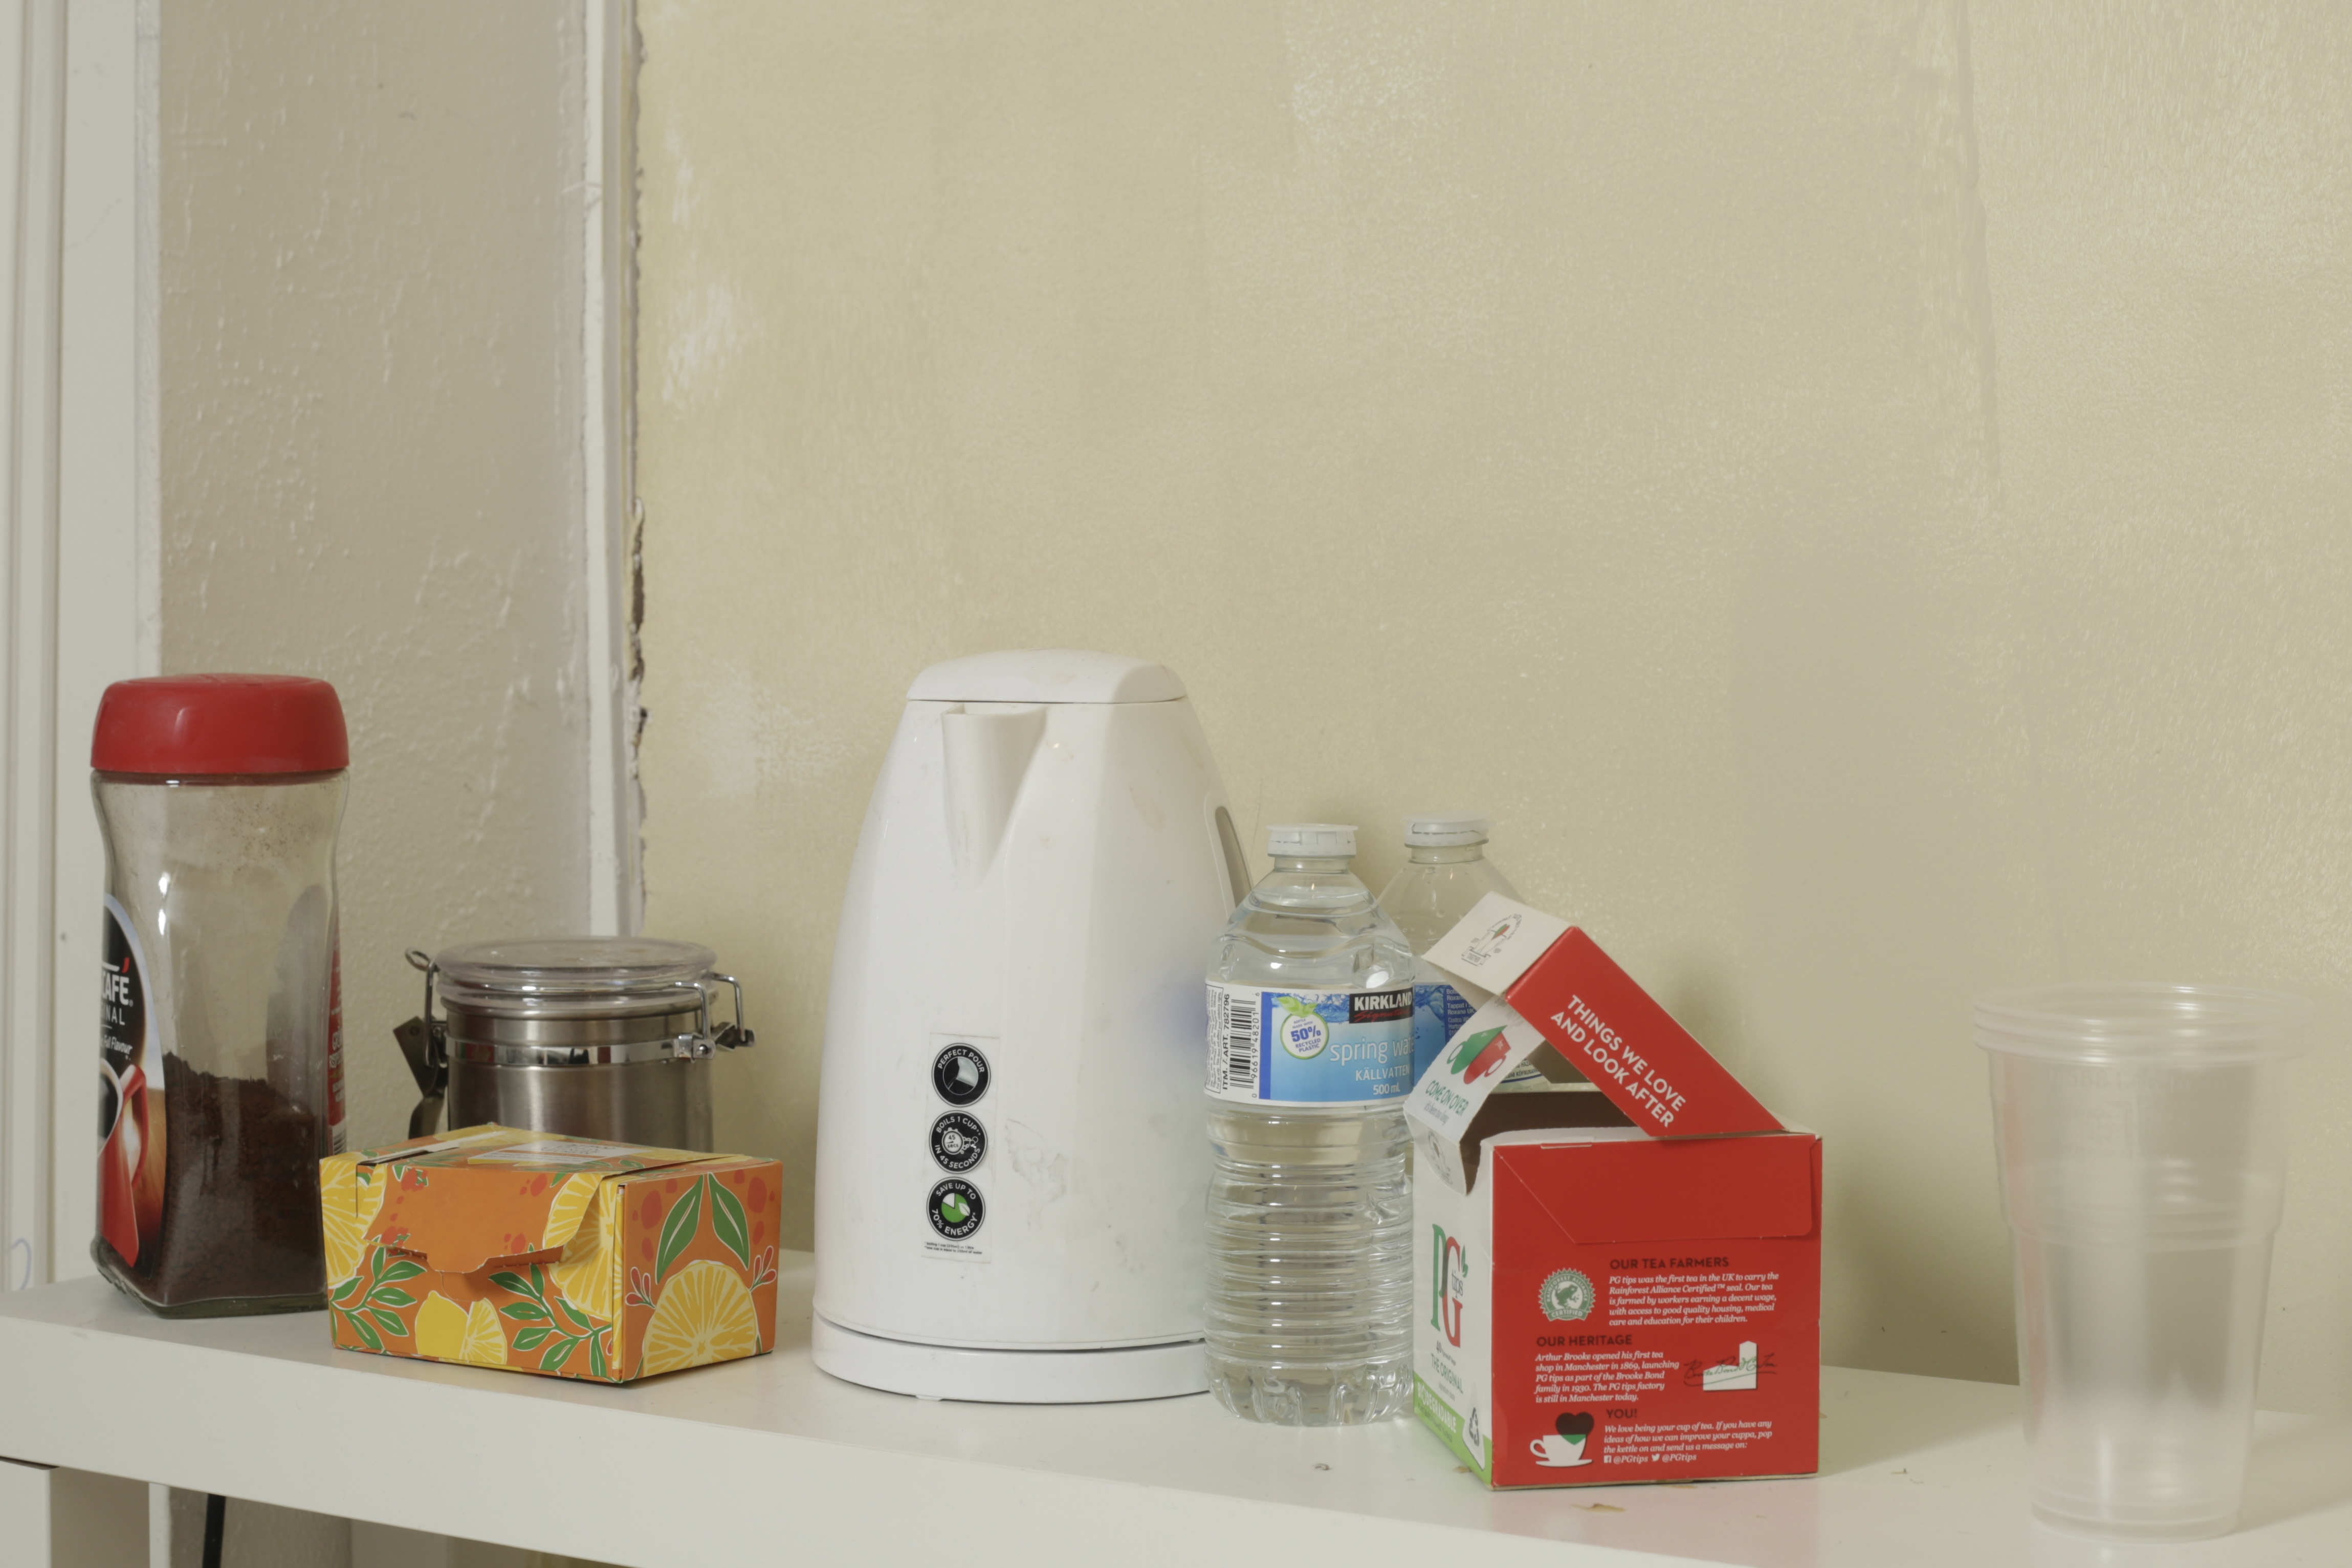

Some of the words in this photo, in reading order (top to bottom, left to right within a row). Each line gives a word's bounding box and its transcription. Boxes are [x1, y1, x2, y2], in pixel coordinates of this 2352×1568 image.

[1354, 991, 1413, 1011] KIRKLAND
[1290, 1025, 1321, 1042] 50%
[1295, 1039, 1321, 1048] RECYCLED
[1299, 1044, 1319, 1052] PLASTIC
[1330, 1037, 1388, 1066] spring
[1393, 1035, 1414, 1057] wate
[1568, 995, 1622, 1051] THINGS
[1622, 1046, 1647, 1074] WE
[1644, 1069, 1686, 1111] LOVE
[937, 1049, 967, 1069] PERFECT
[969, 1052, 984, 1072] POUR
[1356, 1064, 1410, 1080] KÄLLVATTEN
[1550, 1011, 1586, 1043] AND
[1584, 1039, 1629, 1085] LOOK
[1625, 1081, 1674, 1128] AFTER
[1373, 1084, 1389, 1095] 500
[1425, 1080, 1446, 1101] COME
[1441, 1090, 1455, 1106] ON
[1449, 1095, 1468, 1116] OVER
[936, 1116, 955, 1133] BOILS
[935, 1145, 941, 1154] IN
[940, 1156, 949, 1164] 45
[949, 1148, 980, 1168] SECONDS
[936, 1183, 953, 1196] SAVE
[967, 1188, 976, 1199] TO
[932, 1209, 943, 1228] 70%
[1610, 1259, 1638, 1269] OUR
[1642, 1258, 1665, 1269] TEA
[1670, 1257, 1729, 1268] FARMERS
[1431, 1224, 1463, 1348] PG
[1452, 1269, 1463, 1298] tips
[1622, 1276, 1636, 1285] tips
[1667, 1275, 1685, 1284] first
[1547, 1276, 1570, 1301] RAINFOREST
[1572, 1277, 1588, 1301] ALLIANCE
[1609, 1287, 1649, 1296] Rainforest
[1650, 1285, 1681, 1293] Alliance
[1726, 1283, 1743, 1291] seal.
[1616, 1296, 1645, 1306] farmed
[1647, 1296, 1656, 1306] by
[1658, 1295, 1689, 1304] workers
[1690, 1295, 1720, 1304] earning
[1551, 1309, 1583, 1317] CERTIFIED
[1610, 1307, 1626, 1315] with
[1663, 1306, 1682, 1316] good
[1683, 1305, 1710, 1315] quality
[1745, 1303, 1774, 1312] medical
[1628, 1317, 1642, 1325] and
[1681, 1316, 1694, 1326] for
[1715, 1315, 1747, 1323] children.
[1436, 1340, 1441, 1354] 40
[1537, 1336, 1565, 1347] OUR
[1569, 1334, 1632, 1346] HERITAGE
[1535, 1353, 1563, 1361] Arthur
[1564, 1352, 1591, 1360] Brooke
[1592, 1351, 1620, 1362] opened
[1622, 1351, 1632, 1359] his
[1632, 1350, 1651, 1360] first
[1535, 1363, 1554, 1373] shop
[1565, 1362, 1610, 1371] Manchester
[1620, 1362, 1640, 1370] 1869,
[1642, 1360, 1679, 1370] launching
[1431, 1353, 1439, 1373] THE
[1441, 1362, 1463, 1394] ORIGINAL
[1534, 1384, 1560, 1394] family
[1622, 1382, 1636, 1392] tips
[1636, 1381, 1665, 1392] factory
[1569, 1394, 1614, 1402] Manchester
[1615, 1393, 1638, 1402] today.
[1418, 1381, 1456, 1433] BIODEGRADABLE
[1606, 1408, 1637, 1419] YOU!
[1635, 1424, 1656, 1433] being
[1691, 1422, 1701, 1431] of
[1716, 1421, 1723, 1430] If
[1739, 1420, 1756, 1428] have
[1617, 1445, 1638, 1453] kettle
[1651, 1443, 1666, 1452] and
[1666, 1443, 1684, 1451] send
[1702, 1443, 1734, 1451] message
[1614, 1455, 1648, 1464] @PGtips
[1662, 1453, 1697, 1463] @PGtips
